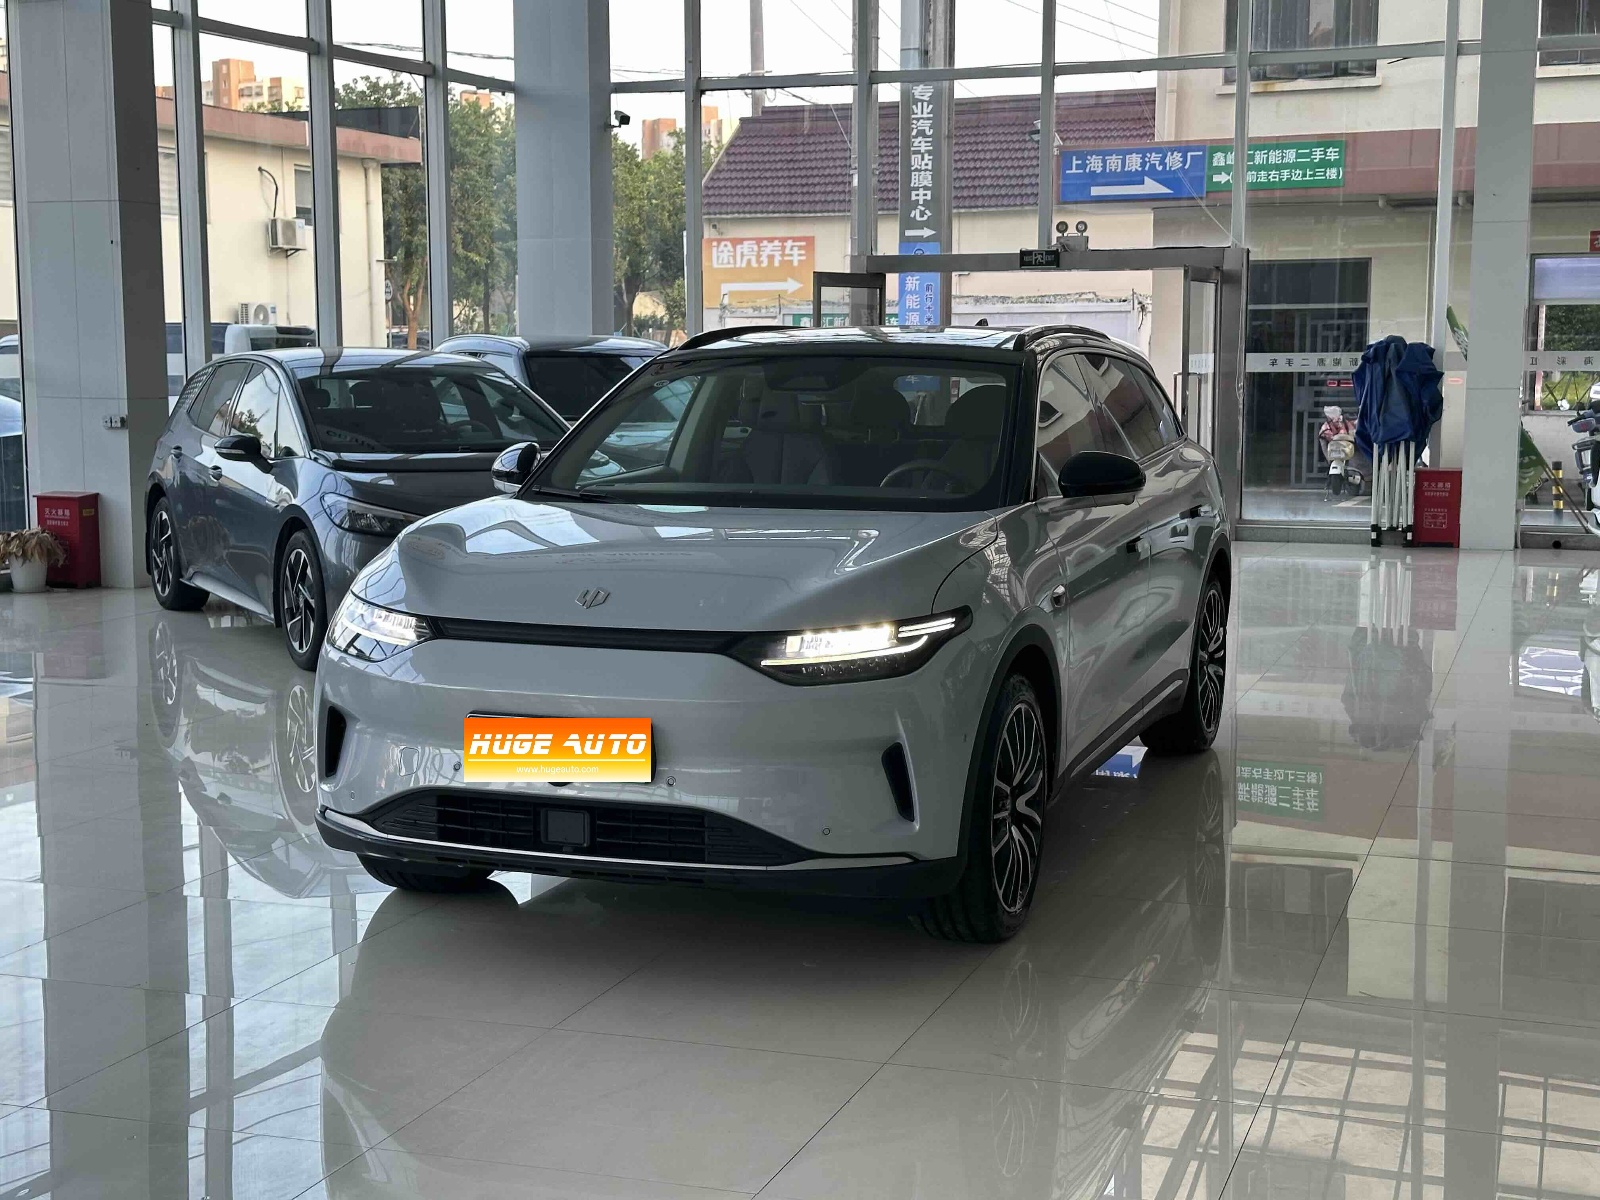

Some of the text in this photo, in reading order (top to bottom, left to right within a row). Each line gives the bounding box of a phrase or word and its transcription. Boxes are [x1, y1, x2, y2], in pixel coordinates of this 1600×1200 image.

[910, 84, 934, 221] 专业汽车贴膜中心
[1065, 151, 1203, 174] 上海南康汽修厂
[711, 239, 807, 269] 途虎养车
[905, 275, 920, 326] 新能源
